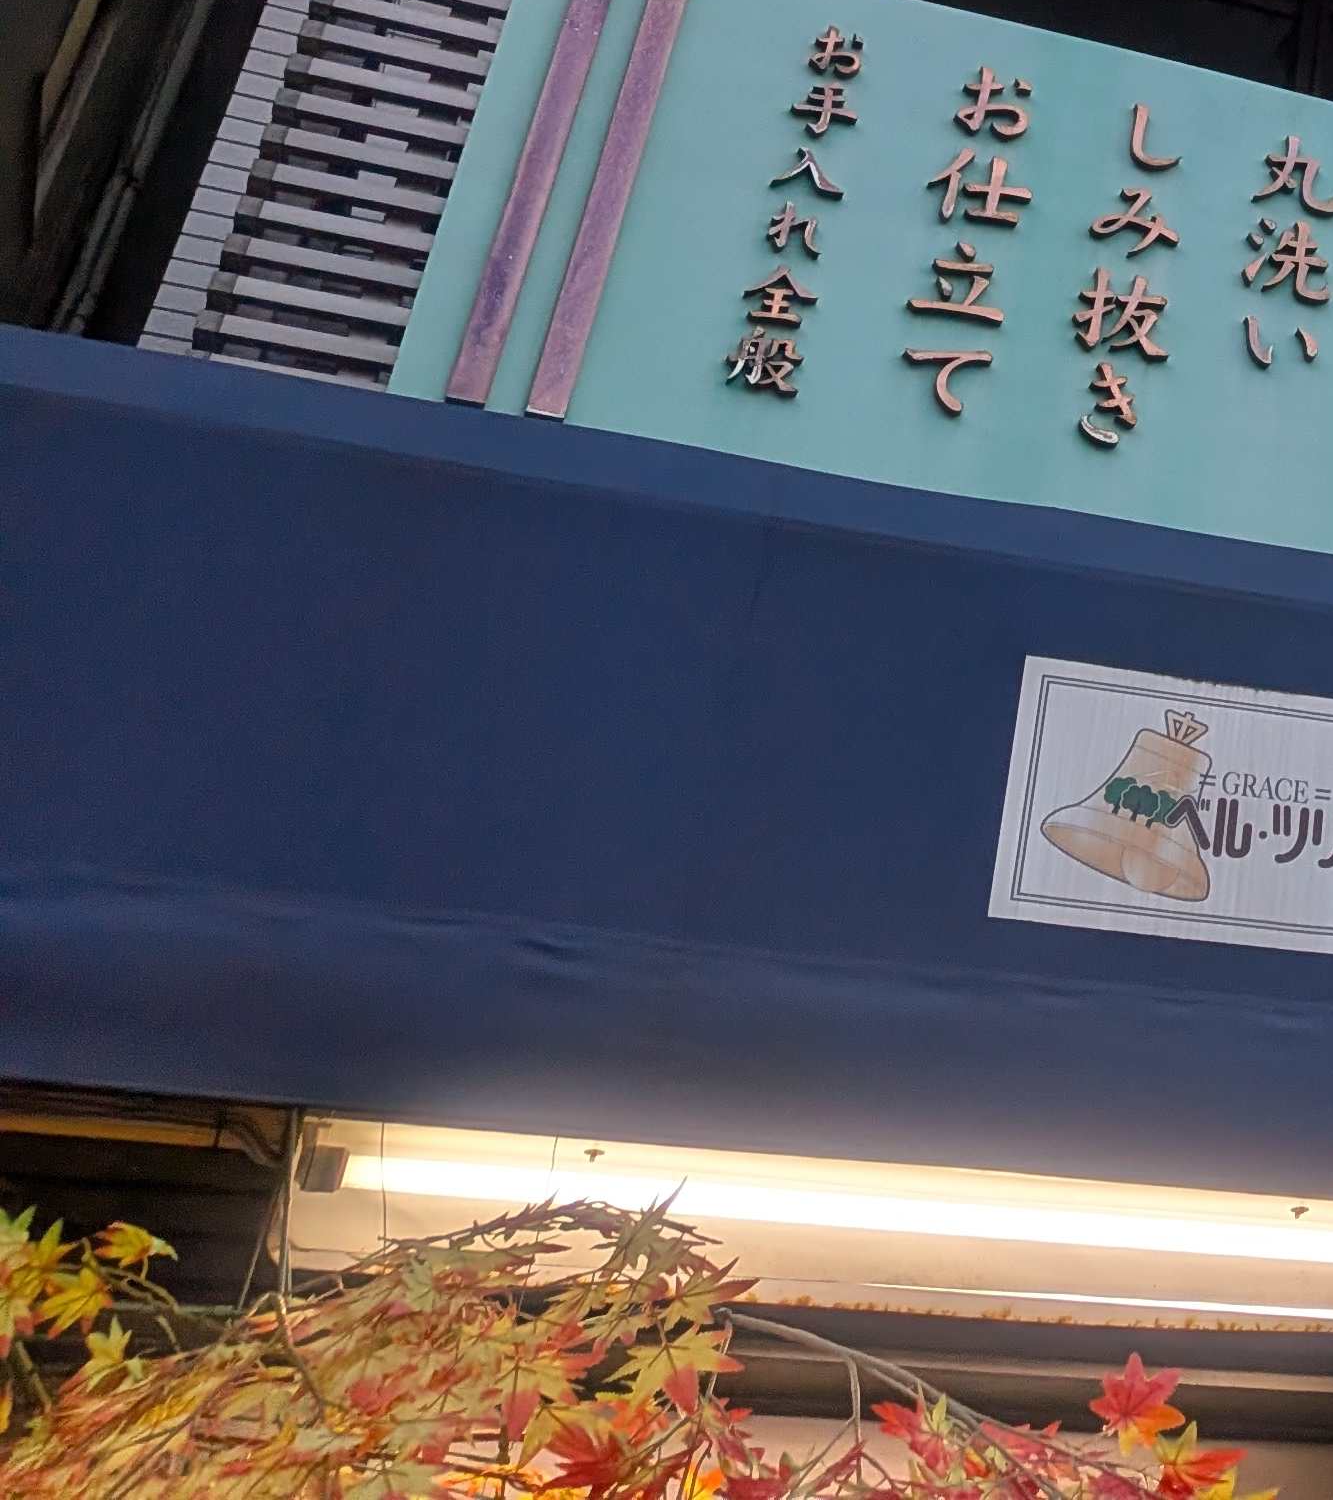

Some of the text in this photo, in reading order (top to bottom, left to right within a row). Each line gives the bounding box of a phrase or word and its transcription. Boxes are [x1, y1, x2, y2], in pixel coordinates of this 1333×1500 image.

[725, 25, 864, 398] お手入れ全般
[902, 66, 1033, 417] お仕立て
[1071, 103, 1181, 450] しみ抜き
[1222, 771, 1309, 804] GRACE
